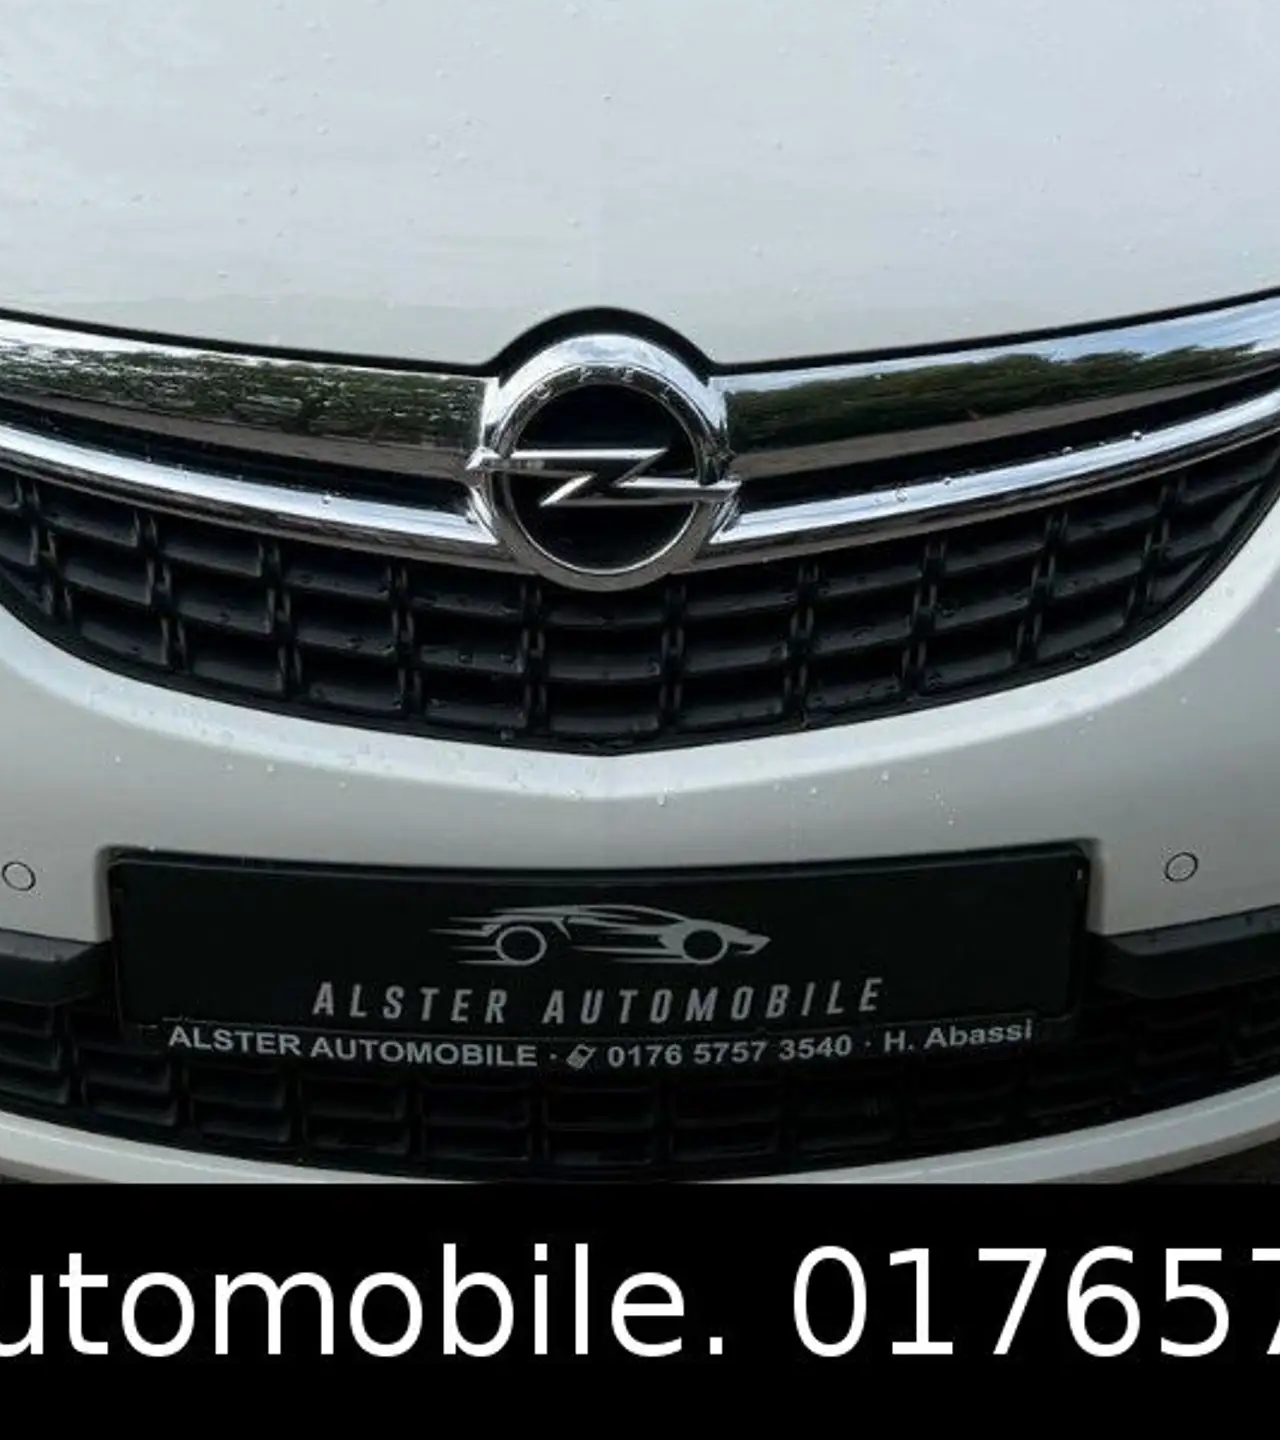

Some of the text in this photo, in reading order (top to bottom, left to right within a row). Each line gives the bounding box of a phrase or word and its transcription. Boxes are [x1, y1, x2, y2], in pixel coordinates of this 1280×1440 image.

[312, 977, 883, 1025] ALSTER AUTOMOBILE
[167, 1018, 1033, 1068] ALSTER AUTOMOBILE 0176 5757 3540 H. Abassi
